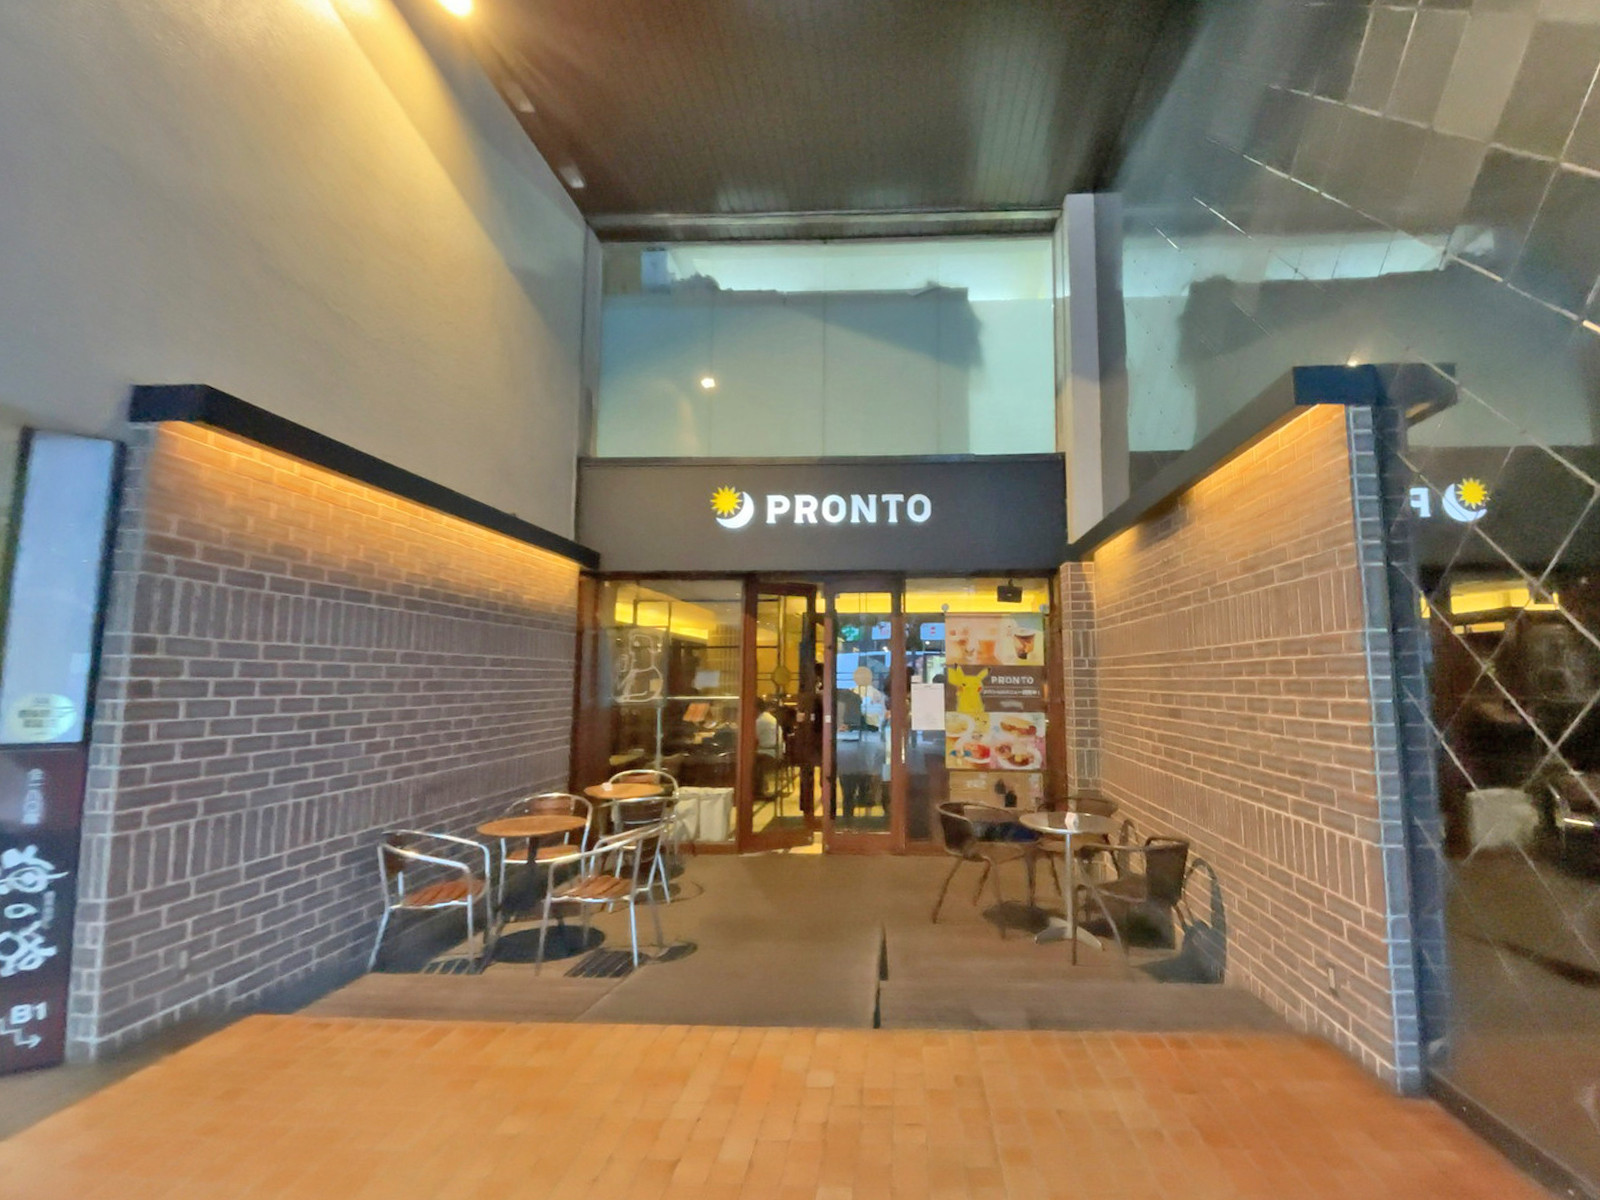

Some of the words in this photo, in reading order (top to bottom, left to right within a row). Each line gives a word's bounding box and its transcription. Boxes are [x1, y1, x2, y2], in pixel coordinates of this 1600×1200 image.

[766, 494, 932, 524] PRONTO
[991, 676, 1034, 685] PRONTO
[10, 1001, 47, 1025] B1
